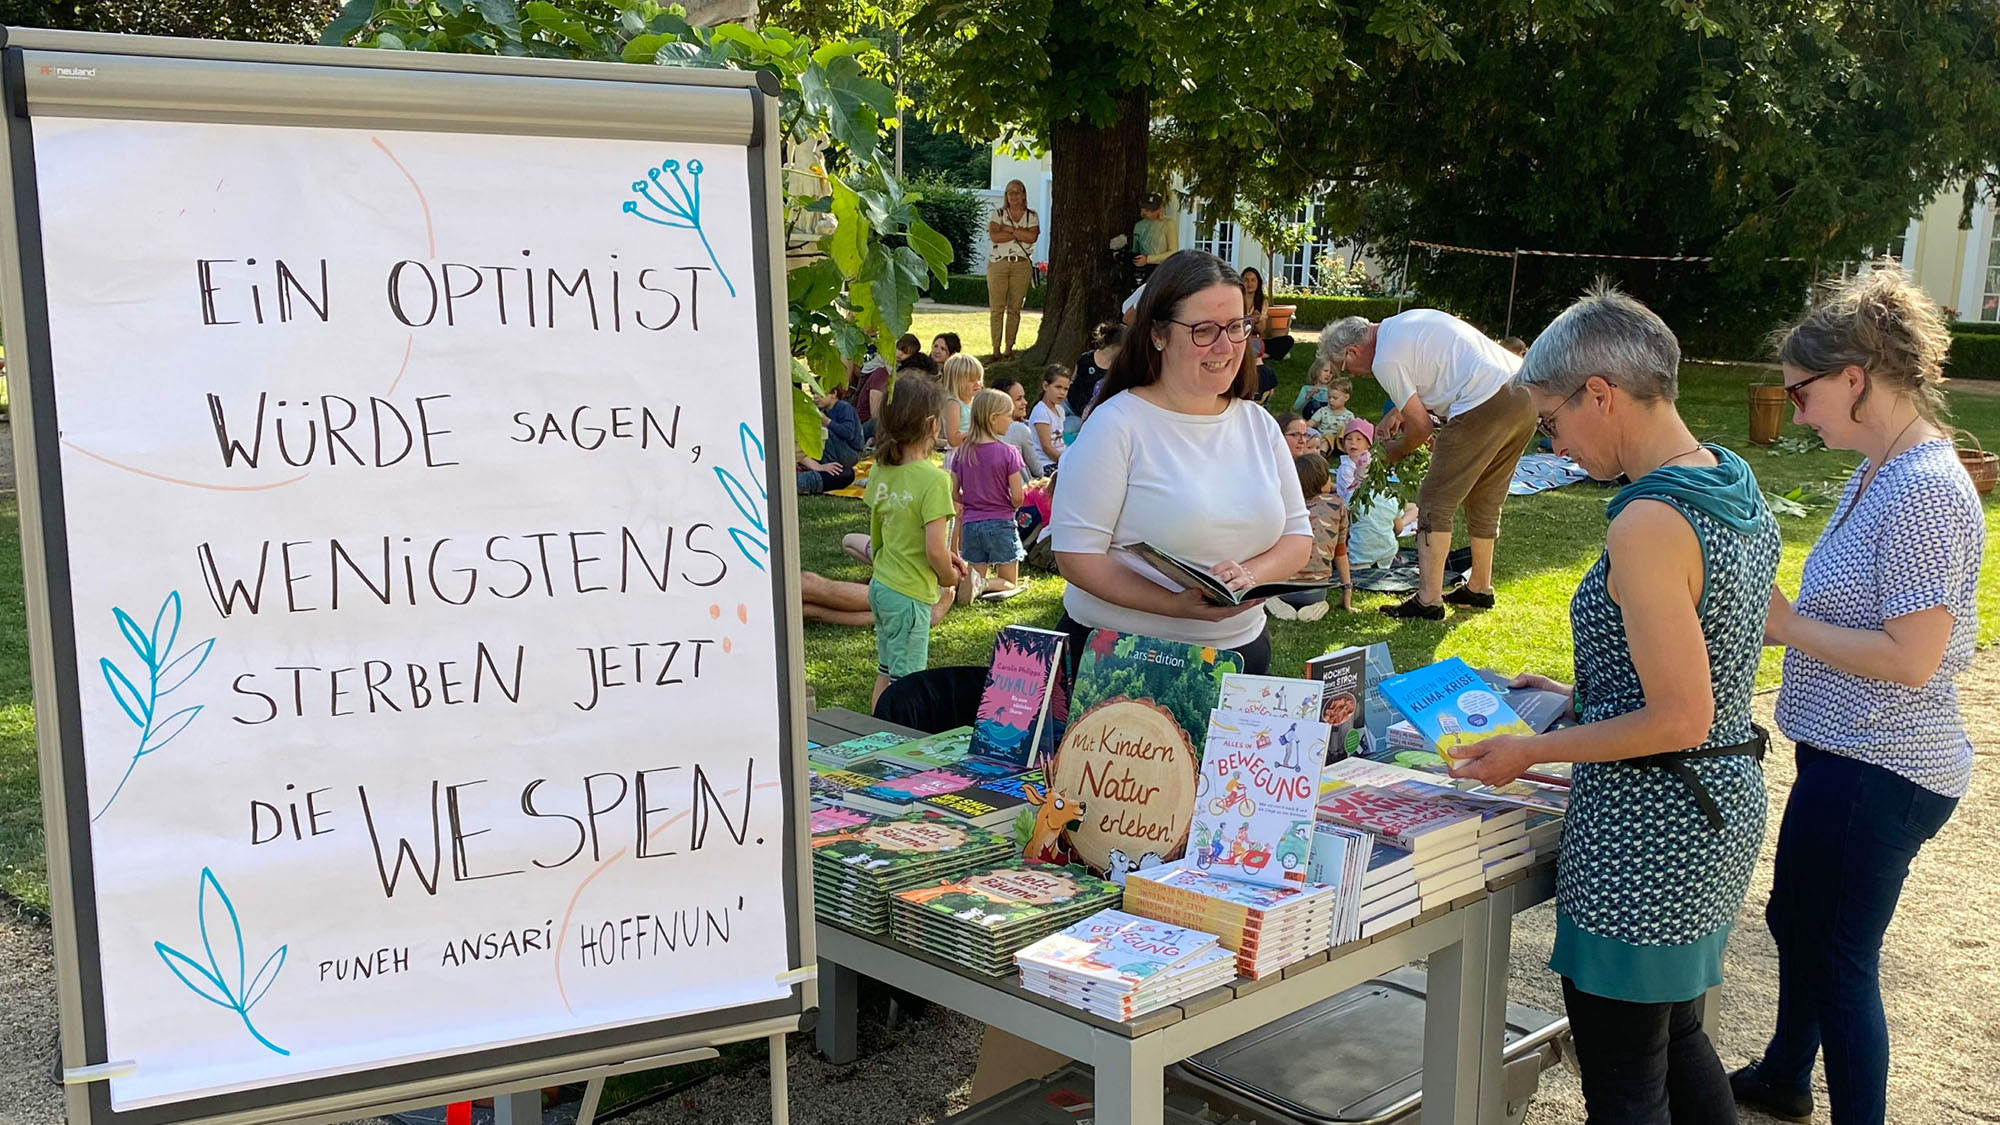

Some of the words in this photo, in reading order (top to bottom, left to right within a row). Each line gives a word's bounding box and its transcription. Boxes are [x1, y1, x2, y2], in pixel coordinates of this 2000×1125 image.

[206, 392, 460, 469] WÜRDE
[511, 405, 701, 464] SAGEN,
[232, 641, 524, 725] STERBEN
[573, 640, 714, 711] JETZT
[993, 674, 1039, 697] TUVALU
[1323, 665, 1351, 681] KOCHEN
[1336, 672, 1358, 686] STROM
[1403, 682, 1438, 704] MEDIEN
[1438, 676, 1449, 688] IN
[1450, 665, 1468, 683] DER
[1410, 673, 1475, 713] KLIMA-KRISE
[1072, 733, 1095, 752] Mit
[1099, 724, 1175, 762] Kindern
[1223, 740, 1244, 750] ALLES
[1078, 760, 1160, 805] Natur
[1217, 750, 1312, 803] BEWEGUNG
[1317, 791, 1385, 815] WIE
[358, 757, 764, 898] WESPEN.
[1099, 809, 1175, 843] erleben!
[979, 878, 1038, 899] Bäume
[1014, 875, 1059, 890] Jetzt
[319, 947, 409, 982] PUNEH
